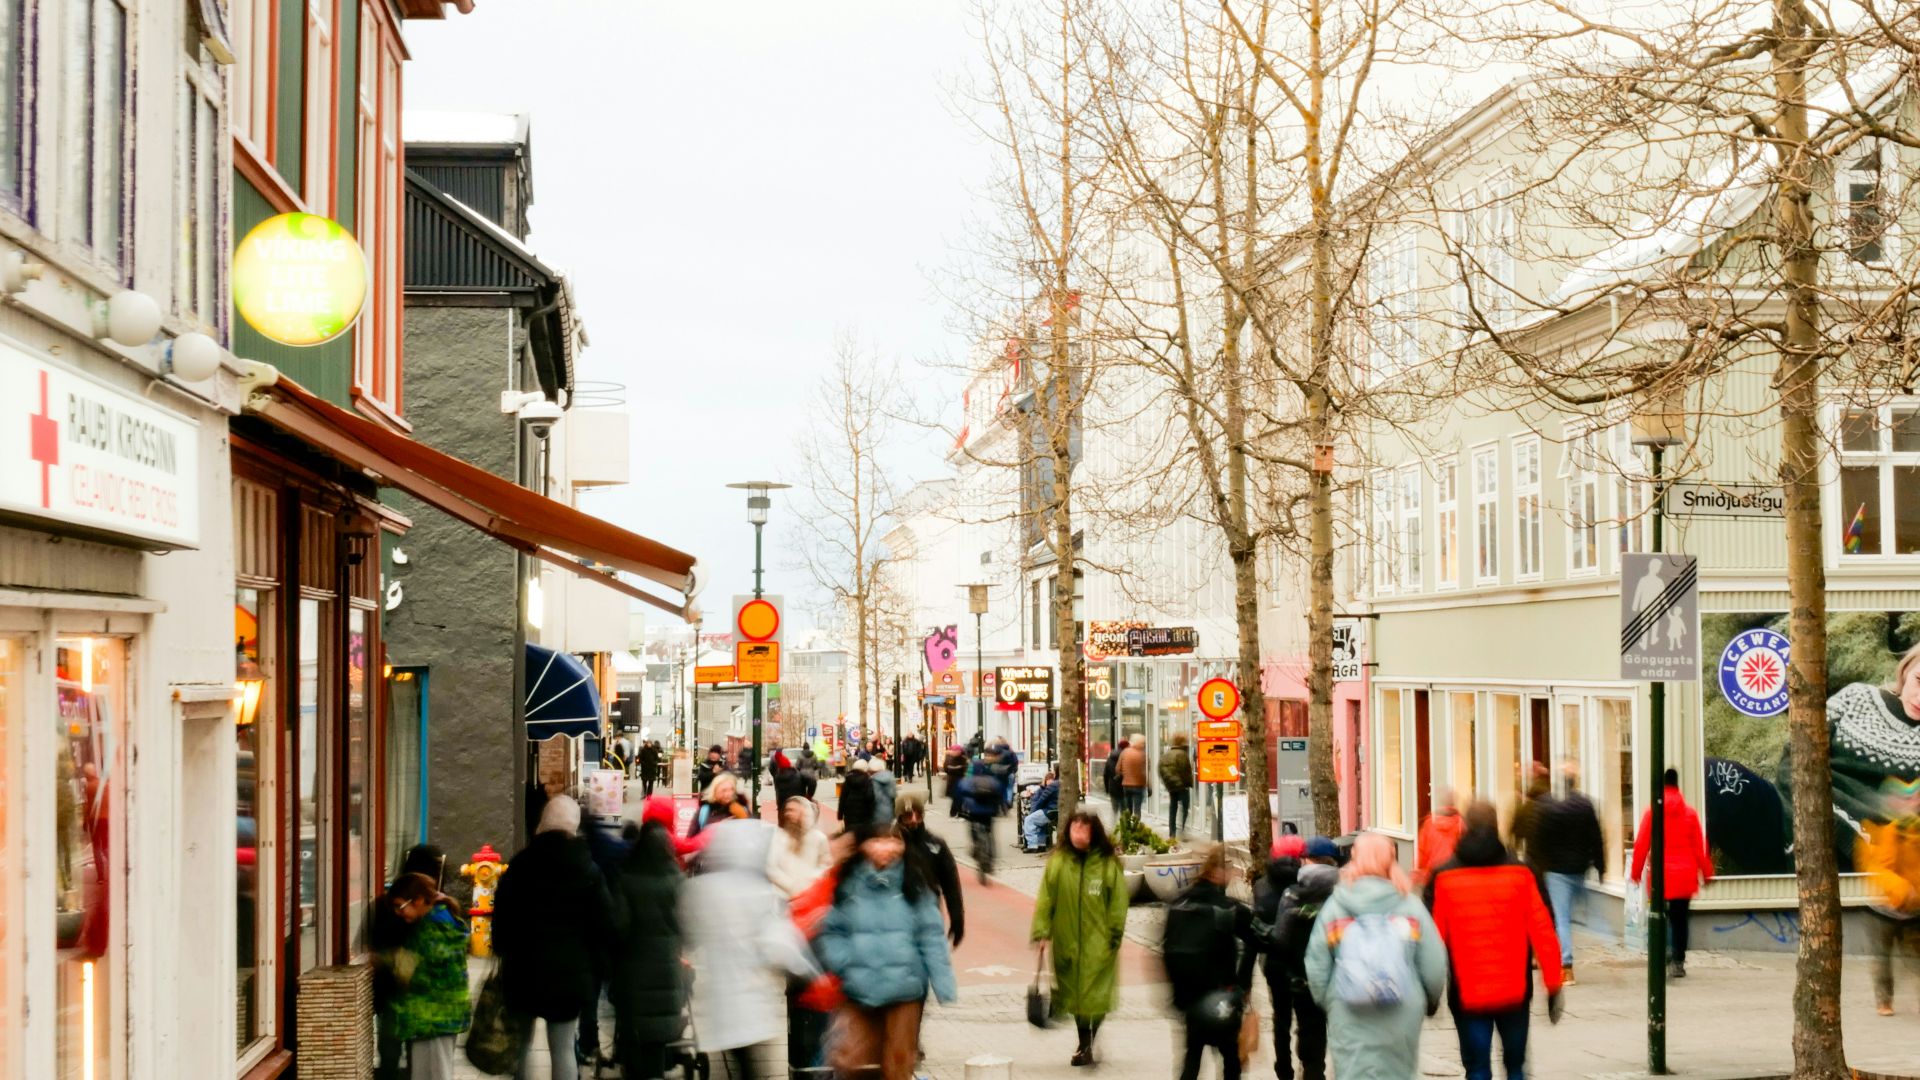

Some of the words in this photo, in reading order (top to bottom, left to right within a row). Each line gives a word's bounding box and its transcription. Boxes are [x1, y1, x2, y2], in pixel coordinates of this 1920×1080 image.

[271, 265, 328, 288] LITE
[265, 291, 334, 314] LIME
[116, 410, 176, 476] KROSSINN
[1683, 491, 1783, 512] Smiðjustigu
[1624, 653, 1694, 666] Göngugata
[1723, 632, 1791, 672] ICEWEA
[1001, 667, 1032, 680] What's
[1034, 667, 1049, 679] On
[1332, 664, 1358, 677] AGA
[1641, 667, 1677, 677] endar
[1017, 683, 1049, 692] TOURIST
[1029, 691, 1049, 700] INFO
[1733, 692, 1788, 711] ICELAND
